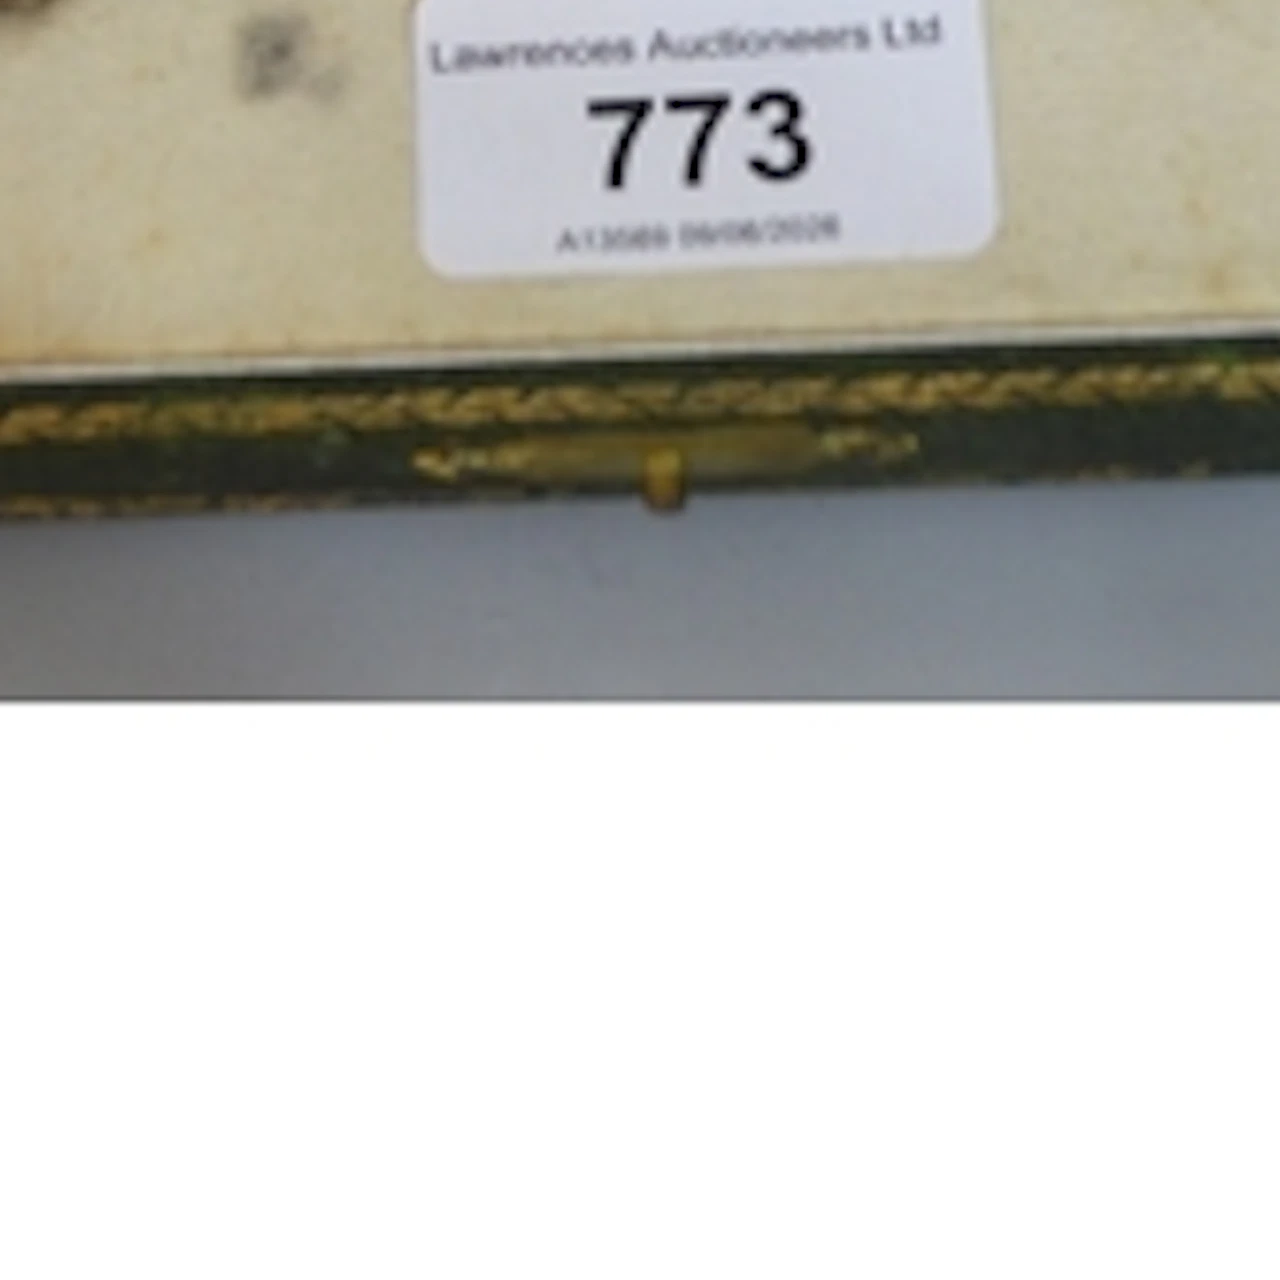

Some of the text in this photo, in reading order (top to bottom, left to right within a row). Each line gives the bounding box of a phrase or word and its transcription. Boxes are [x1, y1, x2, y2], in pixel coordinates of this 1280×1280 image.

[430, 14, 941, 74] Lawrences Auctioneers Ltd
[585, 88, 813, 189] 773
